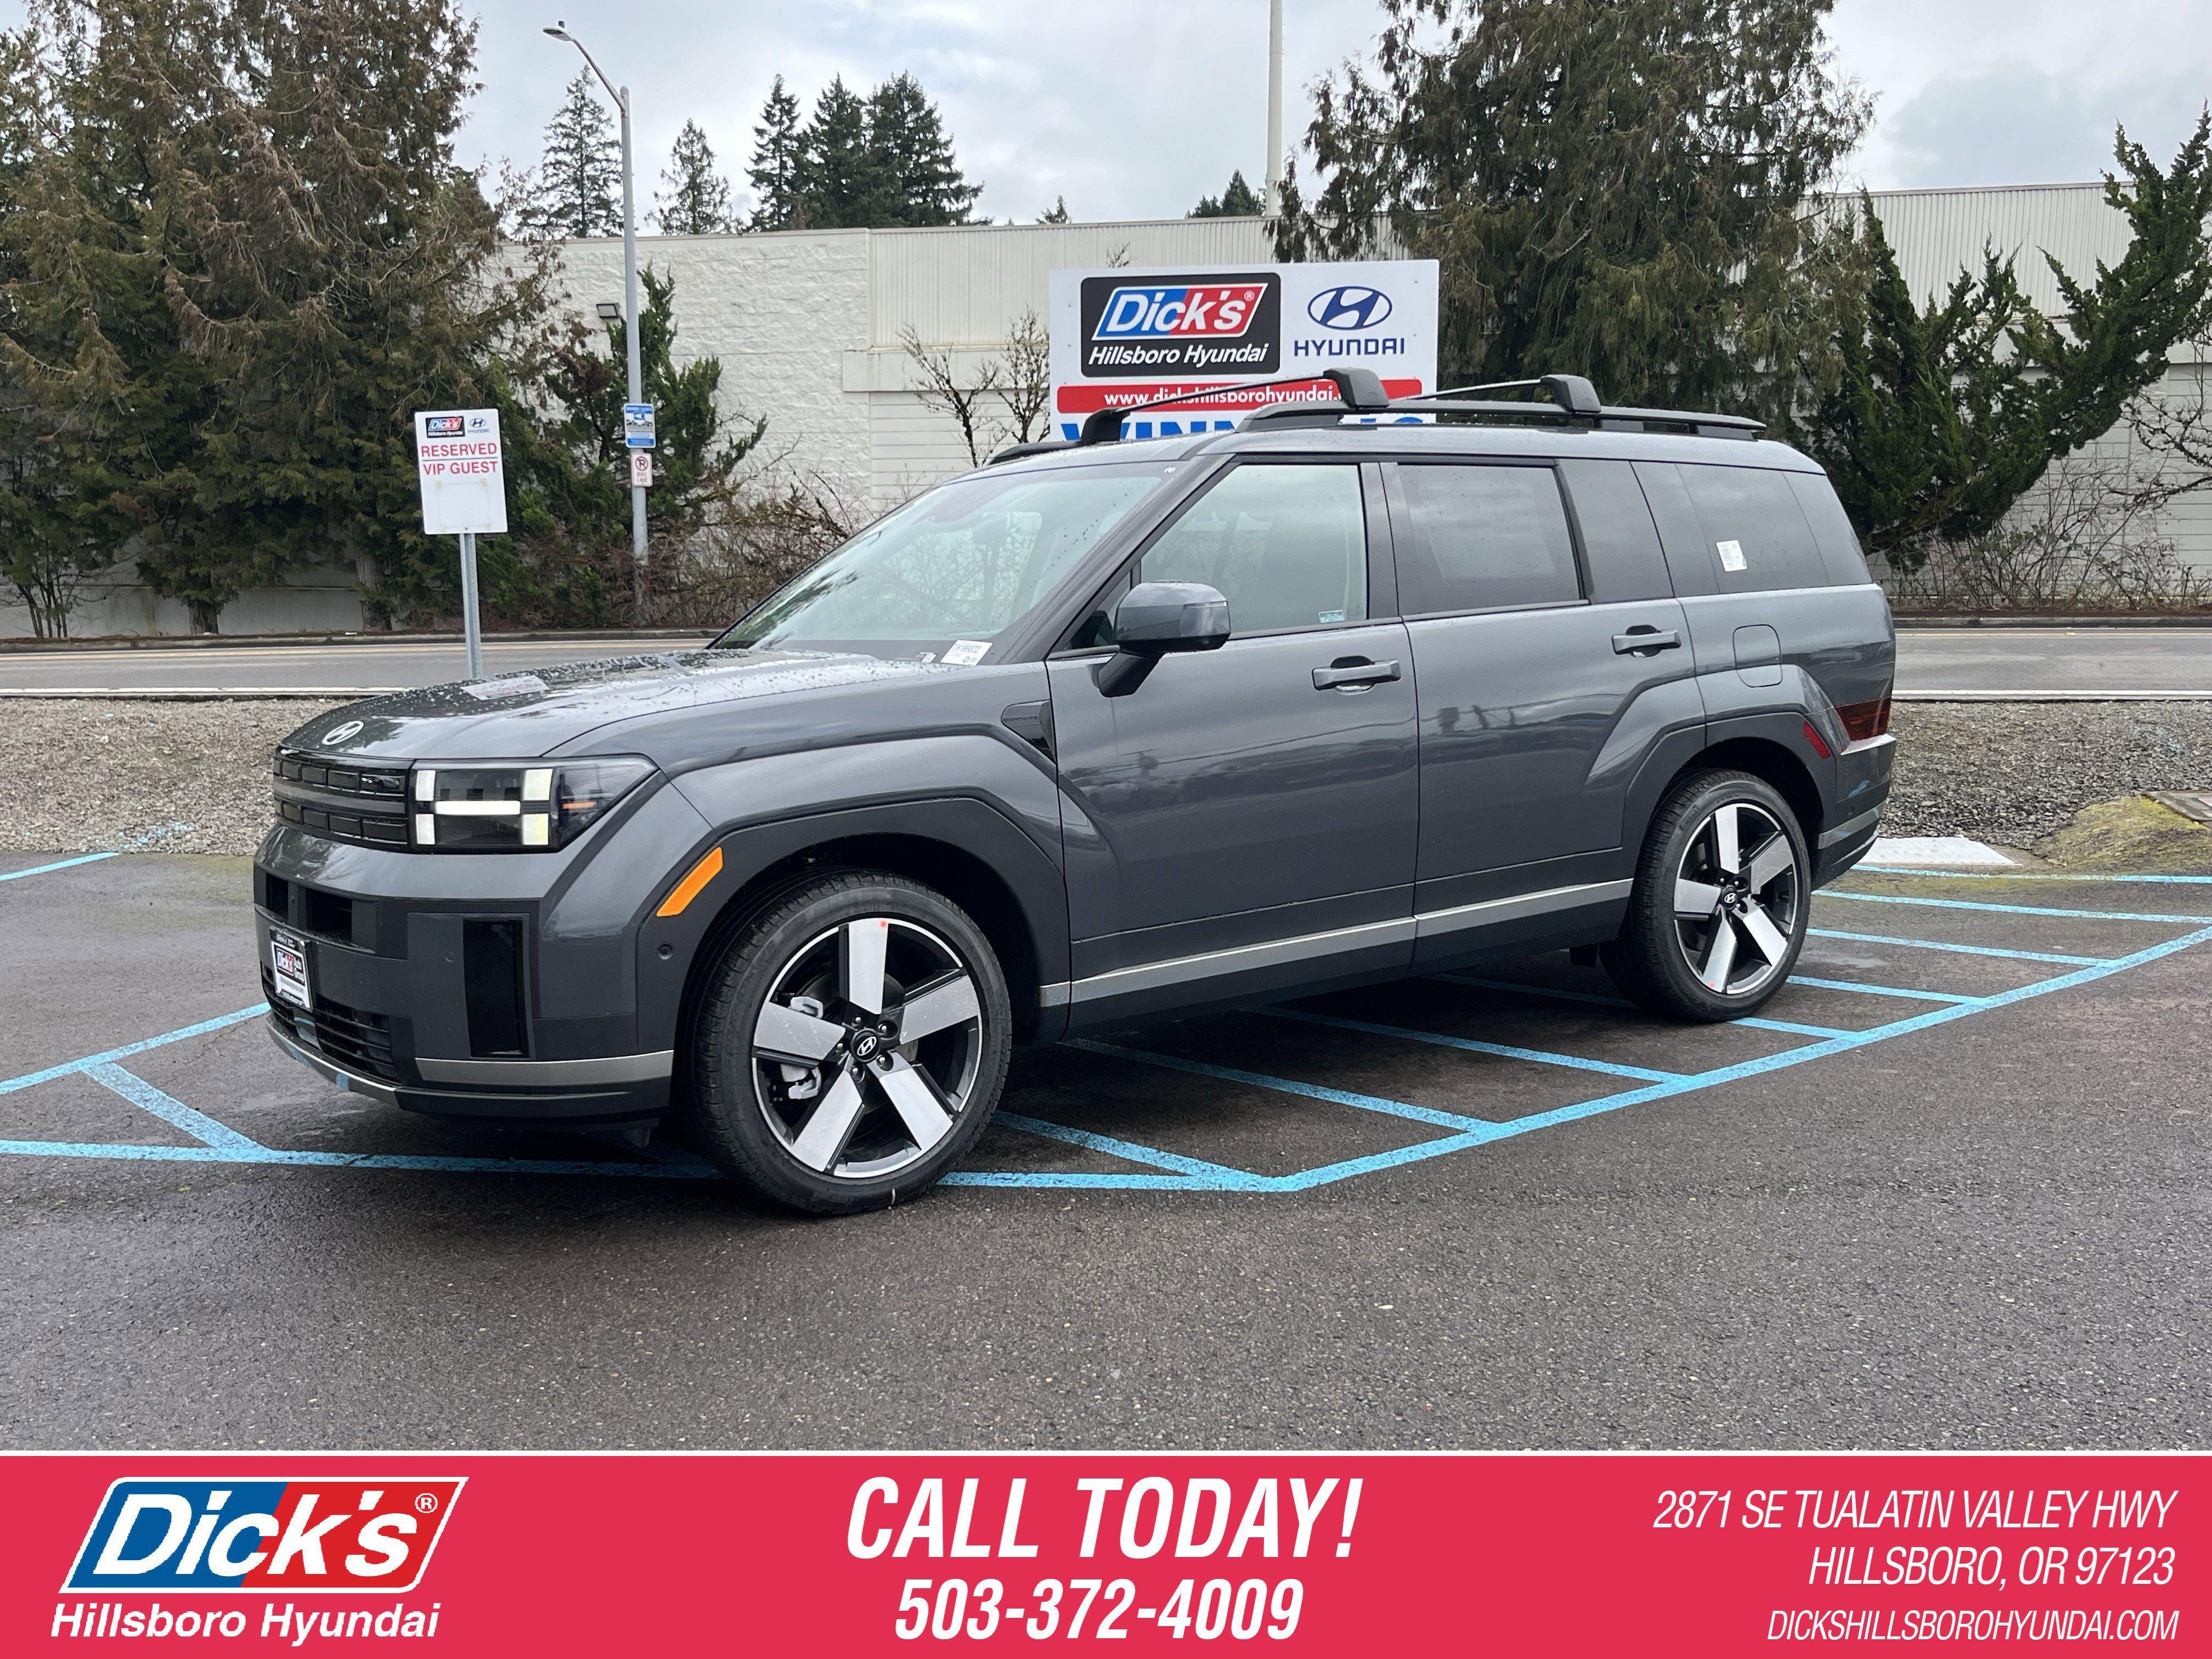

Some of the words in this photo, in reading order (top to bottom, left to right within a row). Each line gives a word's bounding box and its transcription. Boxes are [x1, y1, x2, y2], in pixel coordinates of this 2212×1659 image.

[1105, 291, 1246, 332] Dick's
[1088, 345, 1181, 365] Hillsboro
[1183, 343, 1269, 368] Hyundai
[1294, 338, 1404, 357] HYUNDAI
[421, 443, 497, 457] RESERVED
[423, 464, 445, 475] VIP
[450, 461, 498, 474] GUEST
